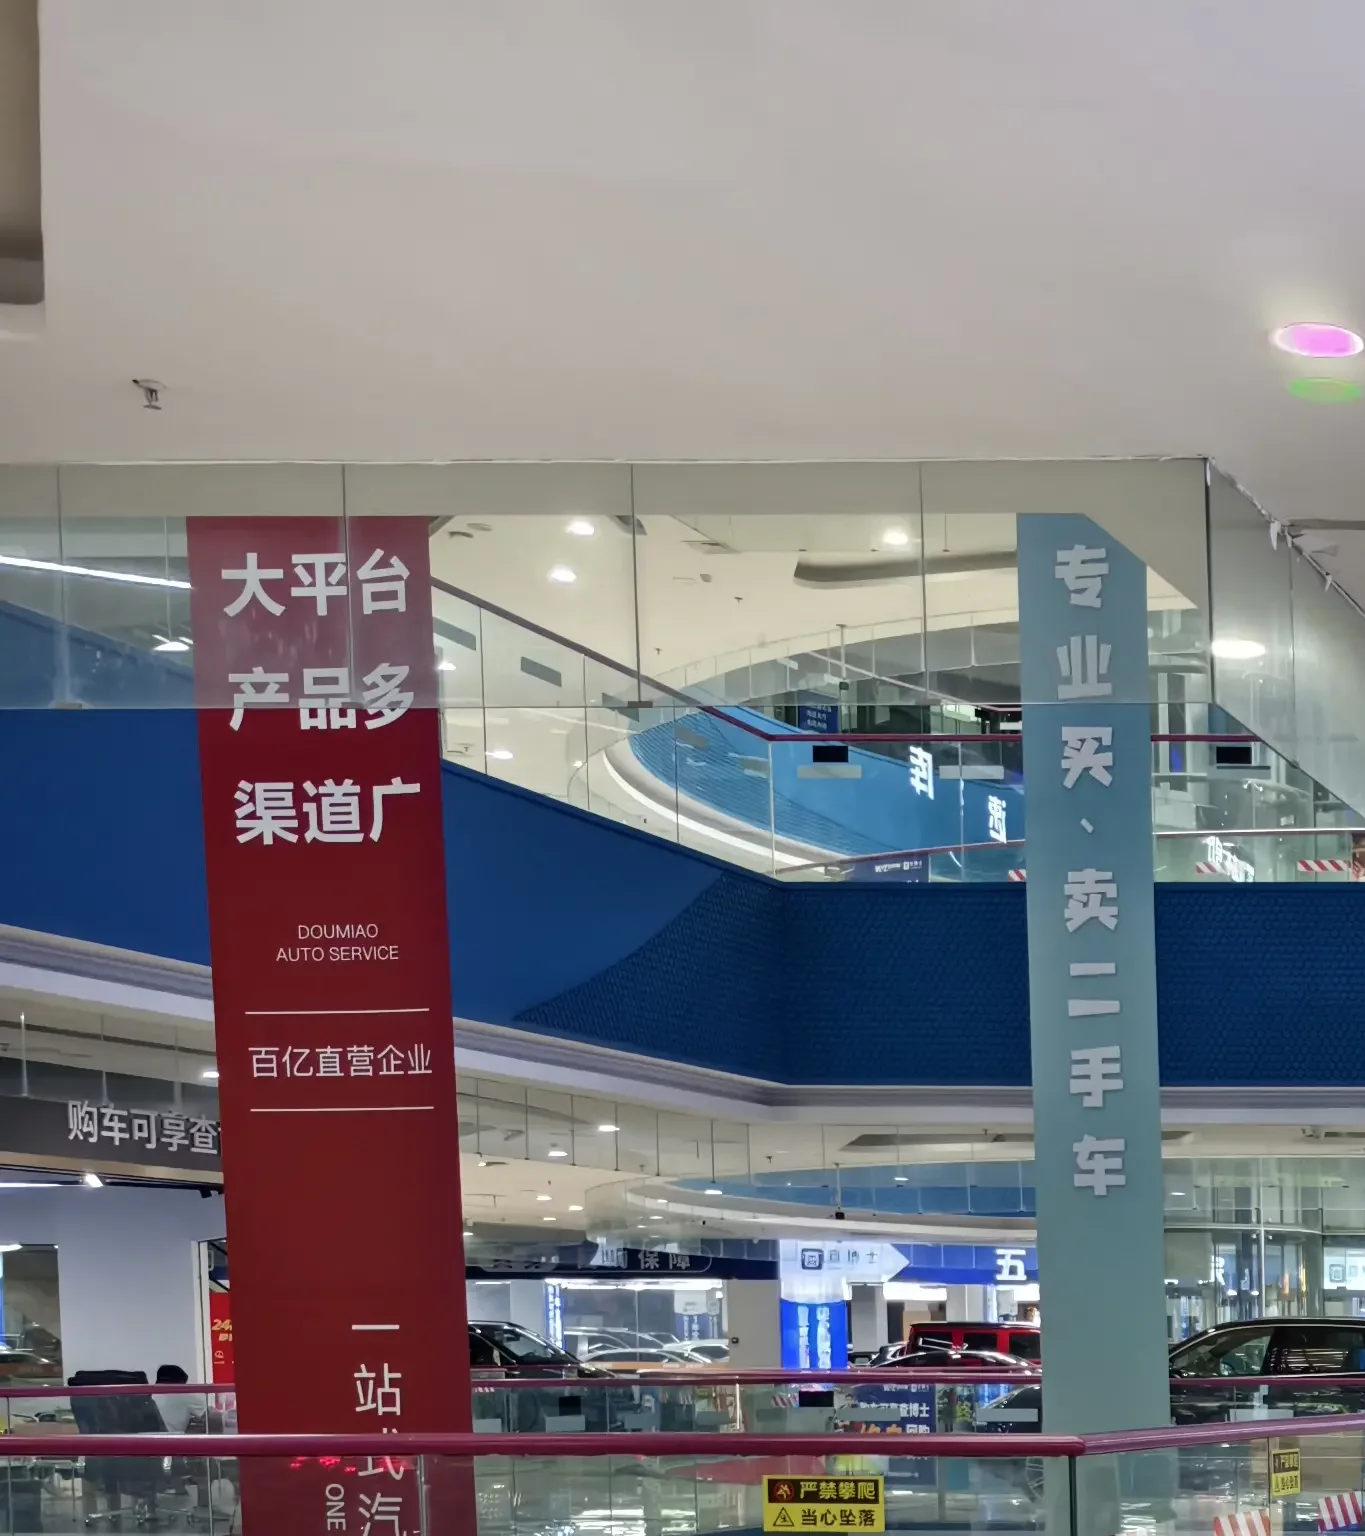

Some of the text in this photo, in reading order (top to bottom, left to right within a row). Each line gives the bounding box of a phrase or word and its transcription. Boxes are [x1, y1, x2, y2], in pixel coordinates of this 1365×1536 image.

[221, 548, 410, 617] 大平台
[228, 662, 415, 732] 产品多
[234, 776, 421, 845] 渠道广
[298, 924, 378, 939] DOUMIAO
[276, 945, 399, 962] AUTO SERVICE
[248, 1043, 433, 1077] 百亿直营企业
[325, 1483, 346, 1531] ONE
[799, 1481, 876, 1500] 严禁攀爬
[801, 1508, 876, 1528] 当心坠落
